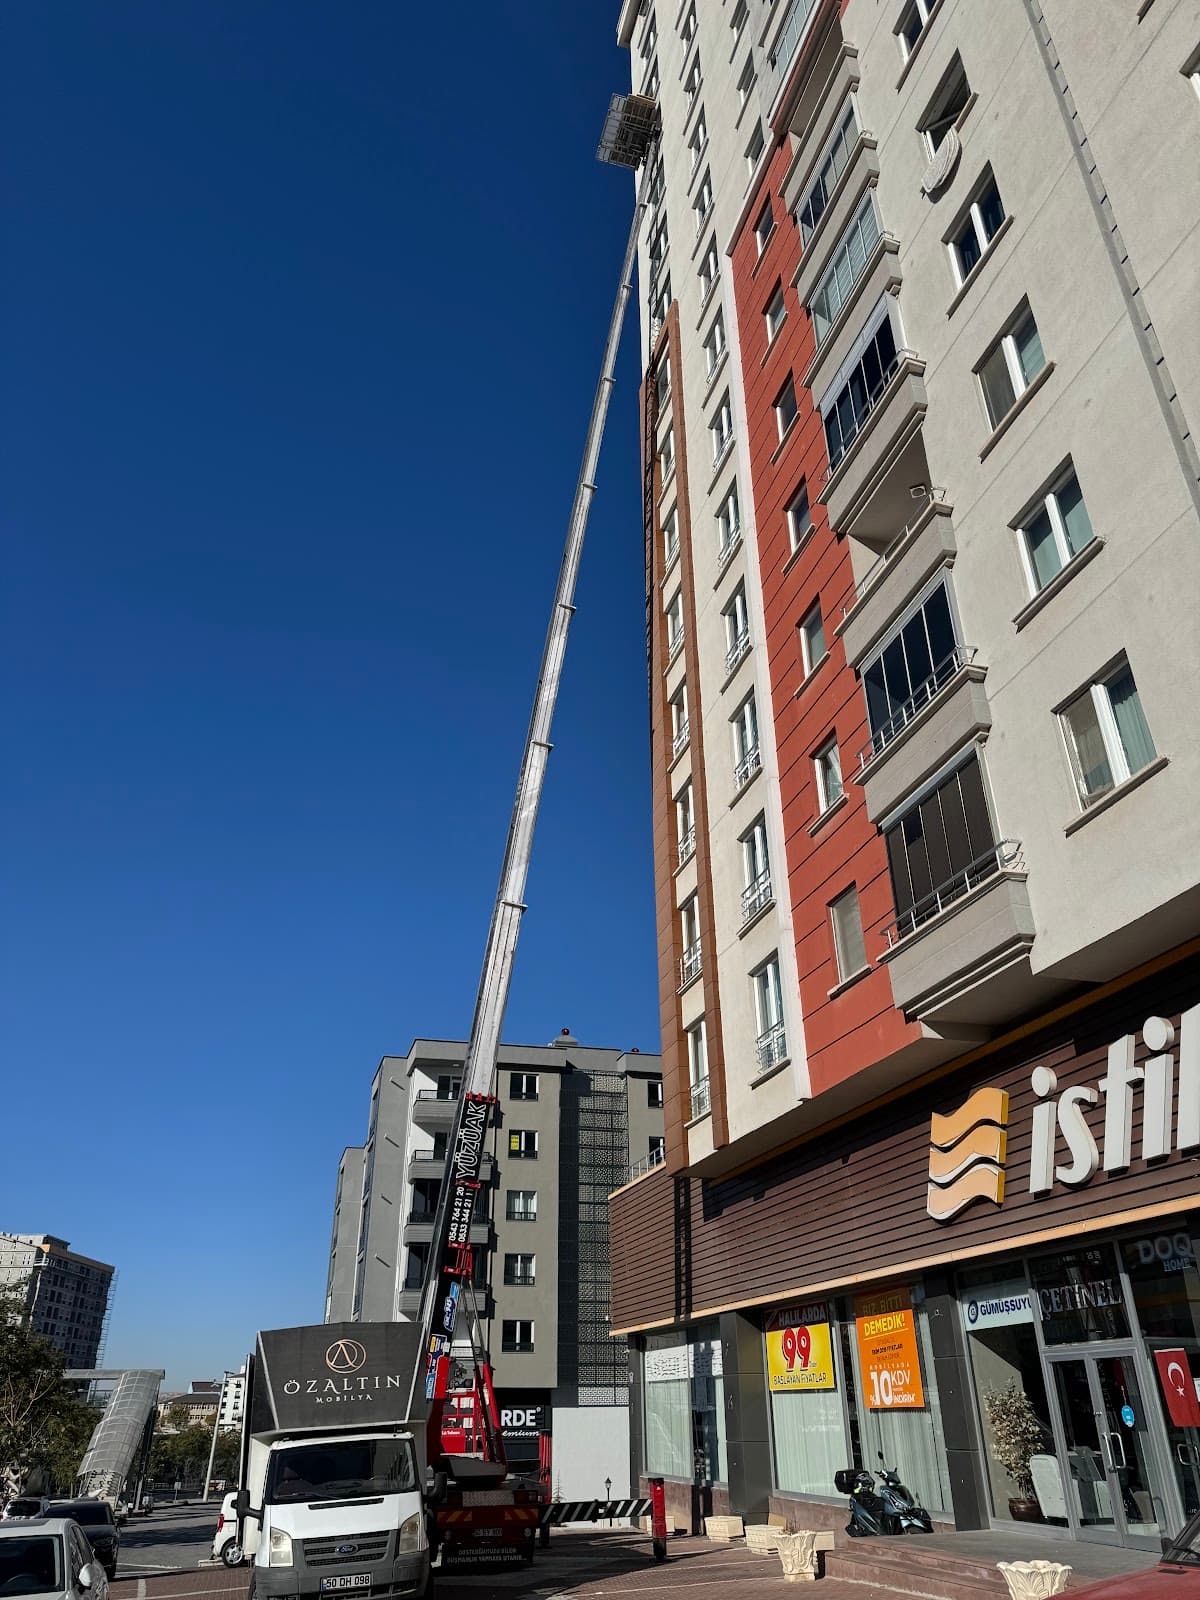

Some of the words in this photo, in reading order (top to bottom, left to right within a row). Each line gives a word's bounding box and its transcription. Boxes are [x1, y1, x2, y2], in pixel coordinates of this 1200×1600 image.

[1162, 1257, 1192, 1272] HOME
[783, 1325, 811, 1372] 99
[284, 1375, 401, 1395] ÖZALTIN
[891, 1369, 911, 1386] KDV
[326, 1578, 337, 1588] 50
[354, 1575, 370, 1585] 098
